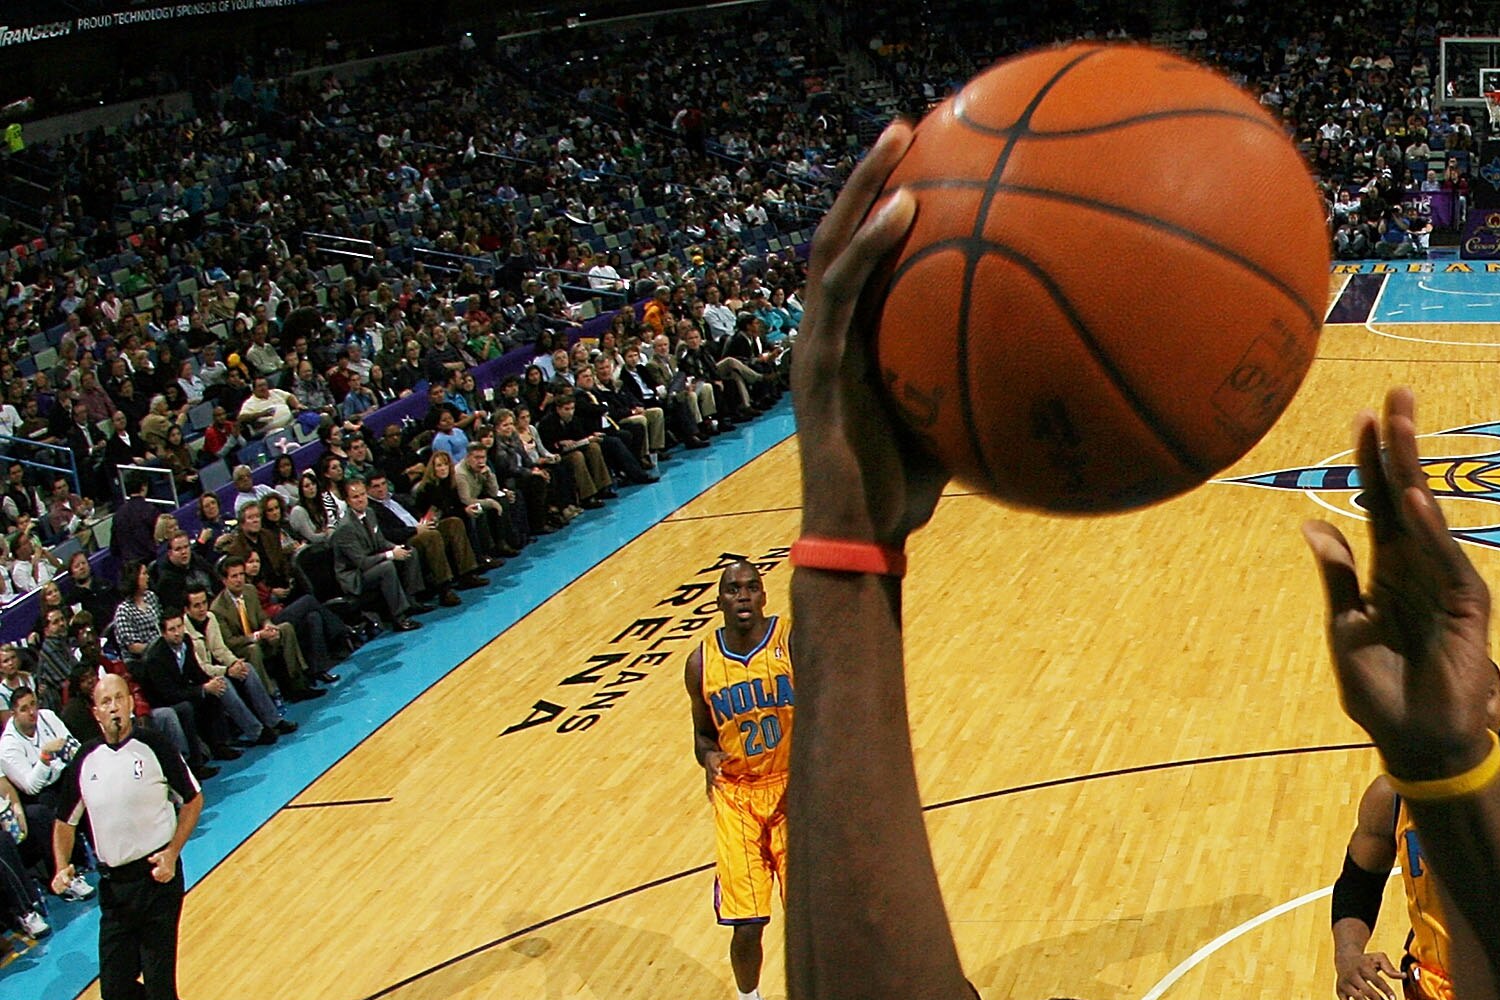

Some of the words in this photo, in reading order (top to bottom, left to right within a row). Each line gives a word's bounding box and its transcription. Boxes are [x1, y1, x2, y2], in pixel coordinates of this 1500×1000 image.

[78, 15, 112, 30] PROUD
[113, 7, 174, 25] TECHNOLOGY
[176, 2, 218, 17] SPONSOR
[218, 1, 230, 12] OF
[710, 673, 795, 727] NOLA
[741, 714, 783, 758] 20
